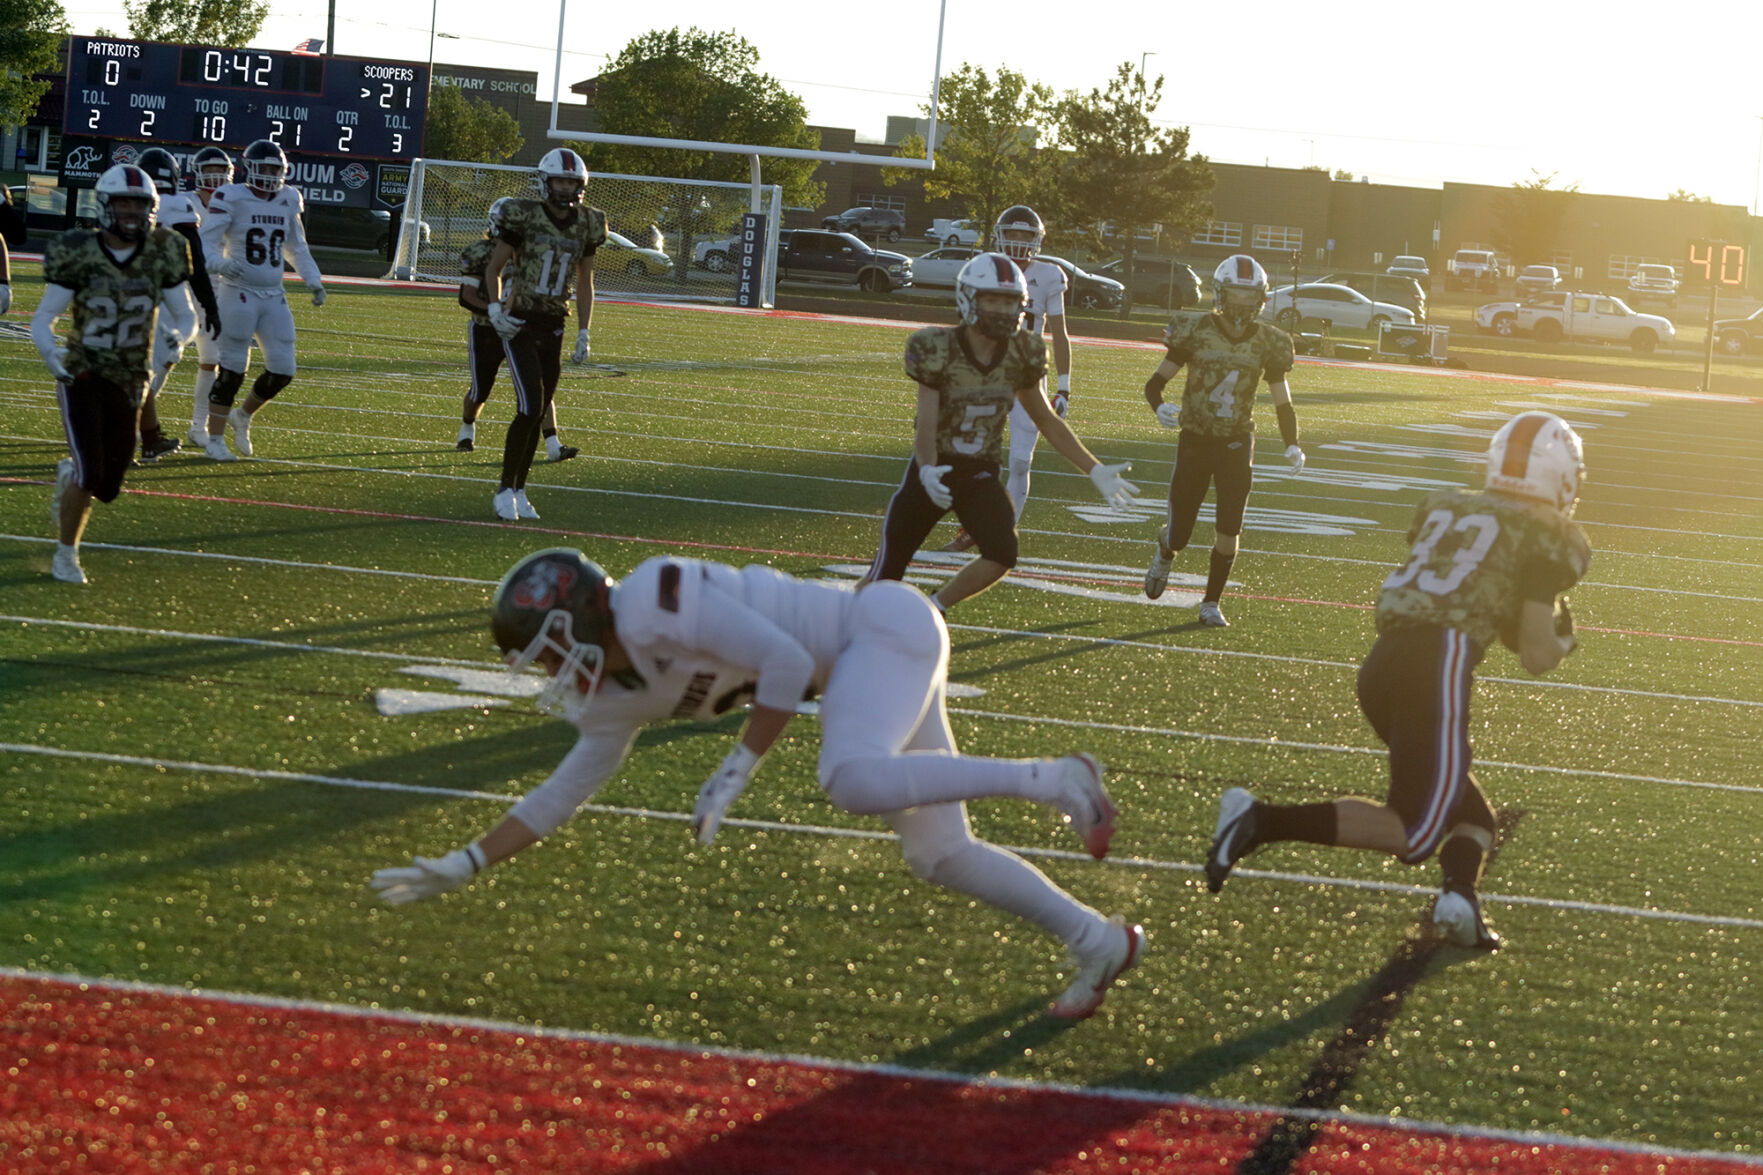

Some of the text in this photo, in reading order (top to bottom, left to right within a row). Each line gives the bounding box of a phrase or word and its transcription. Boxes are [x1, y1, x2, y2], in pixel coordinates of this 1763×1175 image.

[87, 41, 141, 58] PATRIOTS
[105, 60, 120, 86] 0
[204, 50, 273, 86] 0:42
[363, 65, 414, 82] SCOOPERS
[82, 89, 110, 105] T.O.L.
[379, 83, 412, 109] 21
[430, 75, 537, 94] EMENTARY SCHOOL
[130, 93, 166, 110] DOWN
[195, 99, 229, 115] TO GO
[266, 105, 309, 121] BALL ON
[88, 109, 100, 129] 2
[140, 110, 155, 136] 2
[203, 116, 226, 142] 10
[336, 110, 359, 126] QTR
[384, 114, 411, 130] T.O.L.
[269, 120, 301, 146] 21
[338, 126, 353, 152] 2
[392, 133, 402, 153] 3
[381, 187, 408, 195] GUARD
[382, 173, 408, 183] ARMY
[246, 227, 285, 268] 60
[534, 250, 573, 297] 11
[740, 217, 756, 306] DOUGLAS
[1689, 244, 1745, 285] 40
[82, 295, 153, 350] 22
[1209, 369, 1240, 418] 4
[951, 404, 998, 455] 5
[1381, 509, 1500, 596] 33
